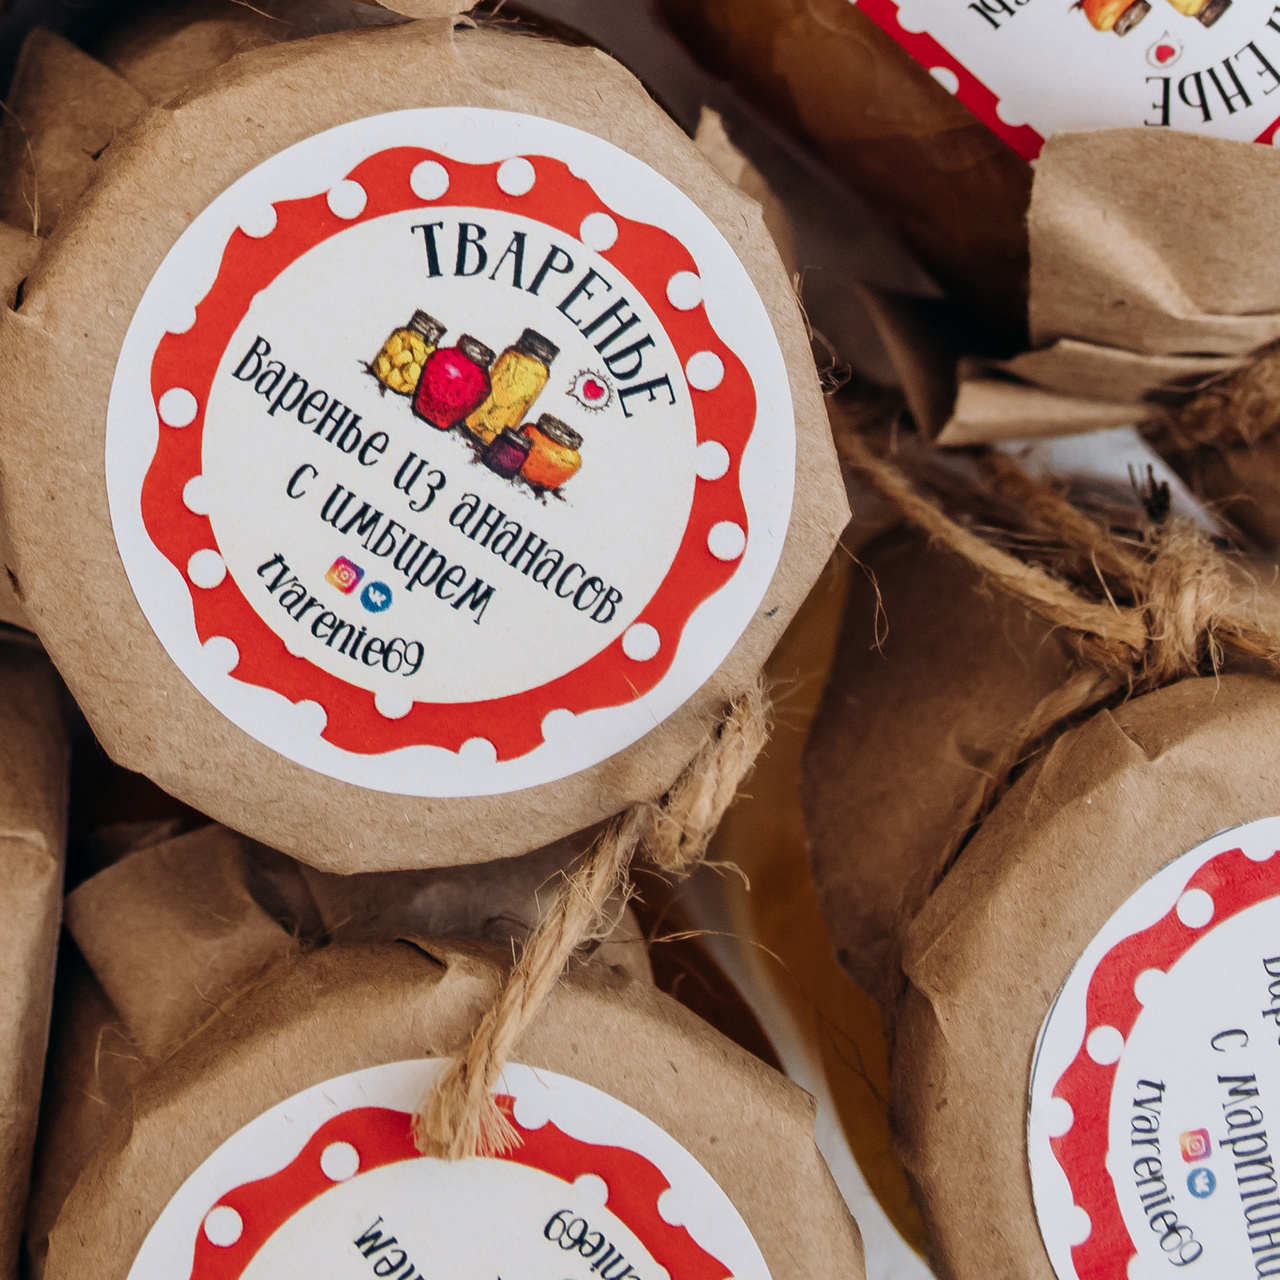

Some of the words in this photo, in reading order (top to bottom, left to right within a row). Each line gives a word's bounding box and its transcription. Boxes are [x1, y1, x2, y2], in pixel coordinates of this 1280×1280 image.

[410, 220, 677, 419] ТВАРЕНЬЕ
[231, 334, 390, 466] Варенье
[393, 451, 447, 508] из
[448, 492, 624, 625] ананасов
[285, 463, 319, 500] с
[319, 482, 497, 621] имбирем
[256, 552, 425, 677] tvarenie69
[1210, 1028, 1250, 1053] с
[1130, 1079, 1204, 1268] tvarenie69
